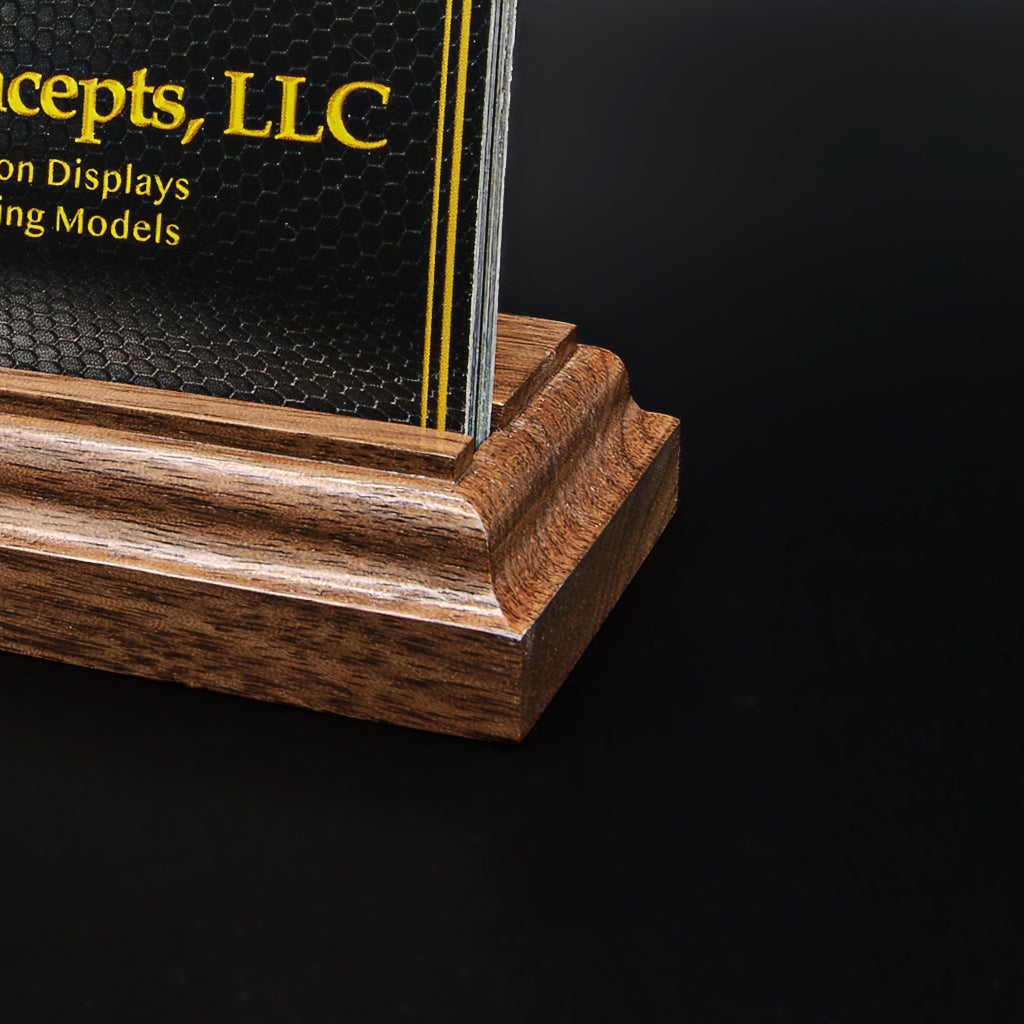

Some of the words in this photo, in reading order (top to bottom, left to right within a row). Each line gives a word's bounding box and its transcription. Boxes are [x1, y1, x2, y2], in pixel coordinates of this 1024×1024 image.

[223, 70, 393, 151] LLC
[47, 158, 190, 206] Displays
[55, 205, 181, 246] Models
